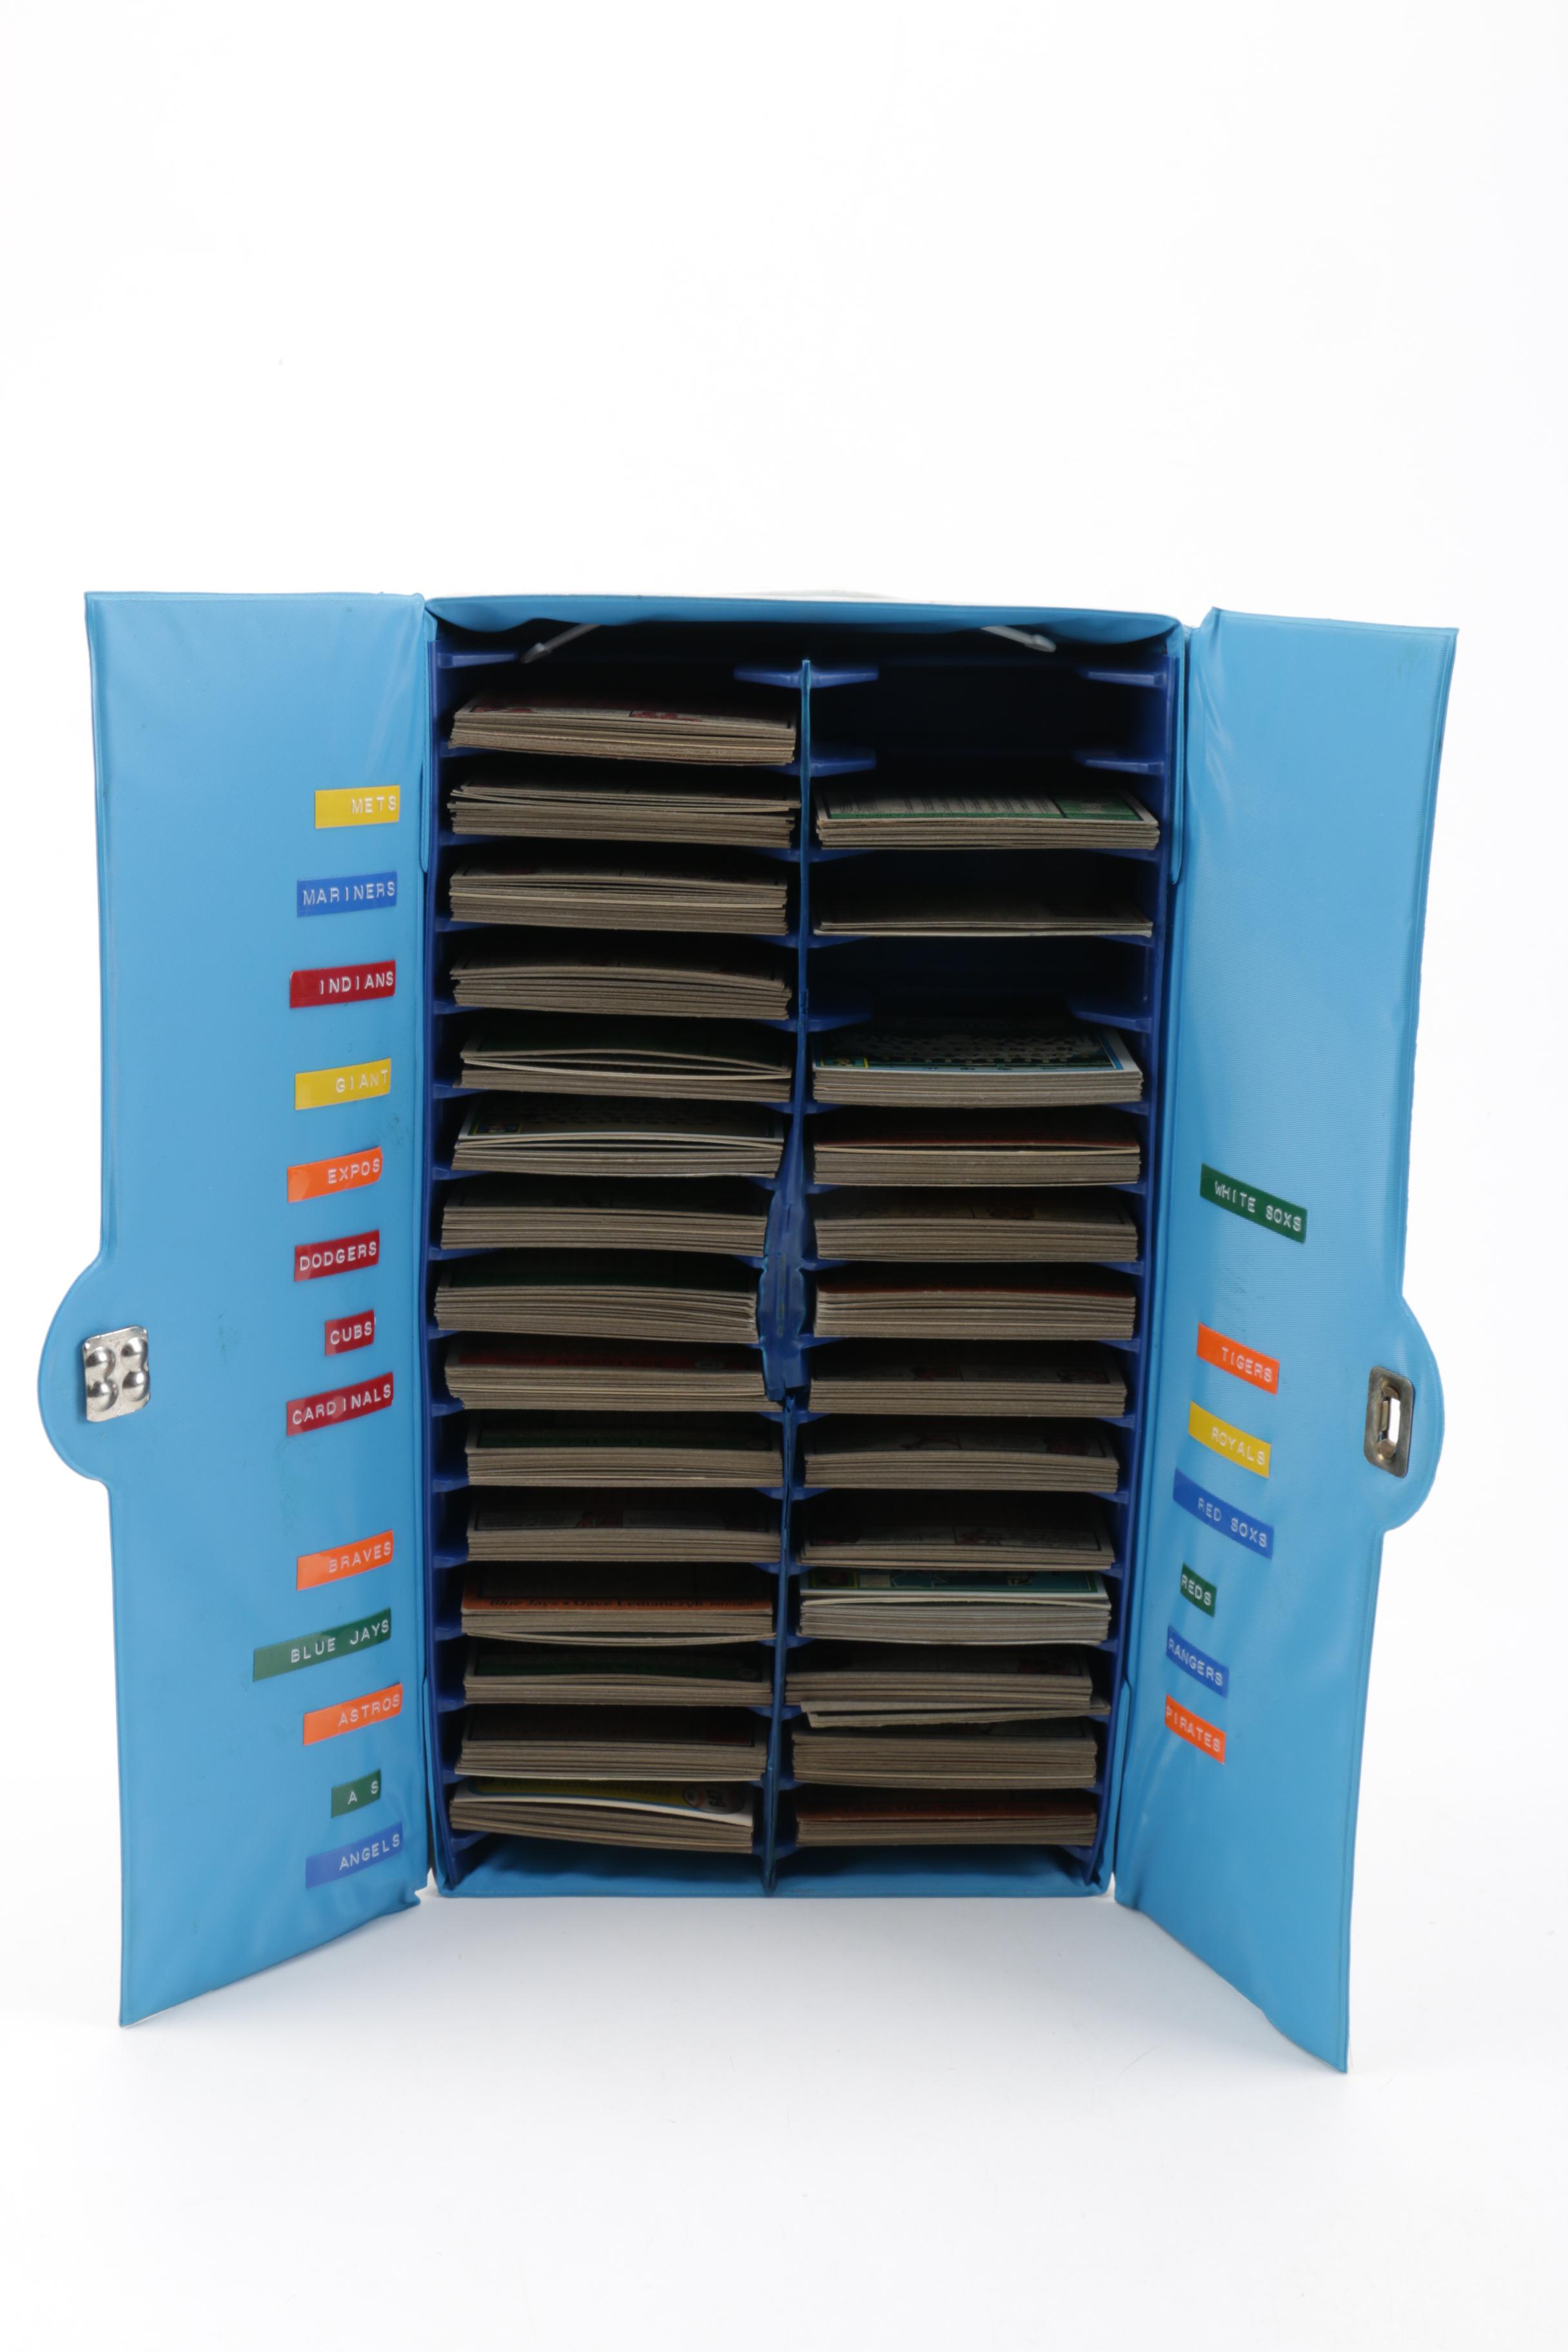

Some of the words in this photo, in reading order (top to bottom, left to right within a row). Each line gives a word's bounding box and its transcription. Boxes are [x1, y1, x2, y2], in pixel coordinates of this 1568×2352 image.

[351, 796, 397, 814] METS
[303, 881, 395, 905] MARINERS
[320, 972, 394, 995] INDIANS
[335, 1070, 388, 1093] GIANT
[328, 1158, 380, 1184] EXPOS
[1215, 1181, 1256, 1213] WHITE
[1266, 1205, 1301, 1232] SOXS
[300, 1241, 377, 1271] DODGERS
[330, 1322, 372, 1345] CUBS
[1221, 1347, 1272, 1383] TIGERS
[292, 1384, 391, 1426] CARDINALS
[1211, 1427, 1265, 1465] ROYALS
[1198, 1498, 1222, 1522] RED
[1231, 1518, 1267, 1547] SOXS
[328, 1542, 391, 1573] BRAVES
[1181, 1574, 1211, 1606] REDS
[291, 1638, 336, 1663] BLUE
[350, 1620, 389, 1645] JAYS
[1168, 1638, 1222, 1687] RANGERS
[338, 1694, 400, 1727] ASTROS
[1166, 1705, 1220, 1753] PIRATES
[348, 1791, 357, 1805] A
[371, 1780, 379, 1795] S
[339, 1834, 400, 1871] ANGELS
